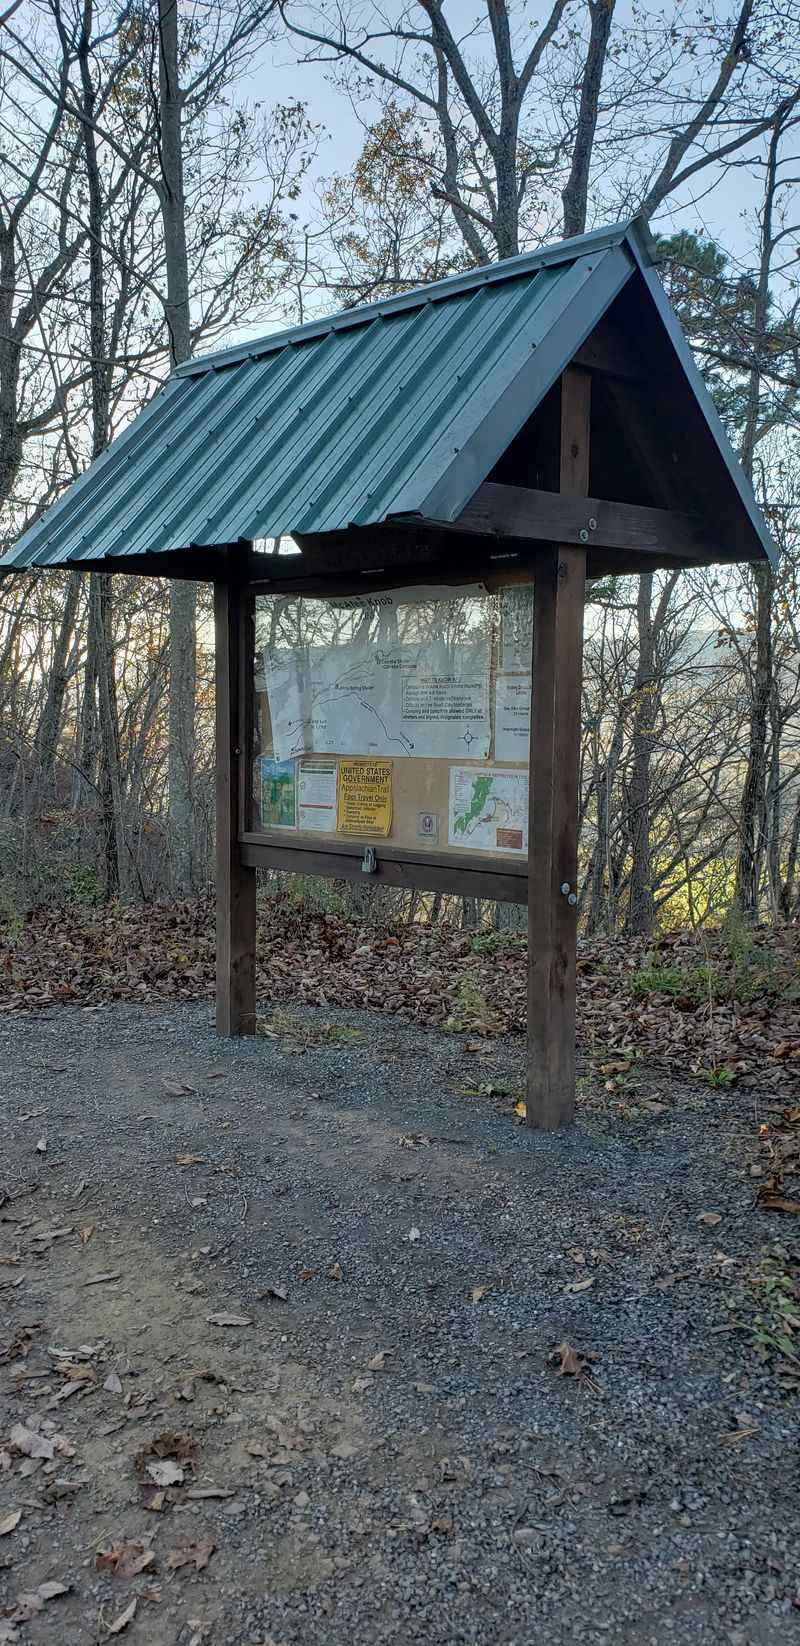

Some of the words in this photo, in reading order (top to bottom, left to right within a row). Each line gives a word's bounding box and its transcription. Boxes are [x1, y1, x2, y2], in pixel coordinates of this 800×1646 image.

[367, 595, 393, 608] Knob
[341, 767, 365, 775] UNITED
[366, 767, 391, 776] STATES
[343, 774, 388, 784] GOVERNMENT
